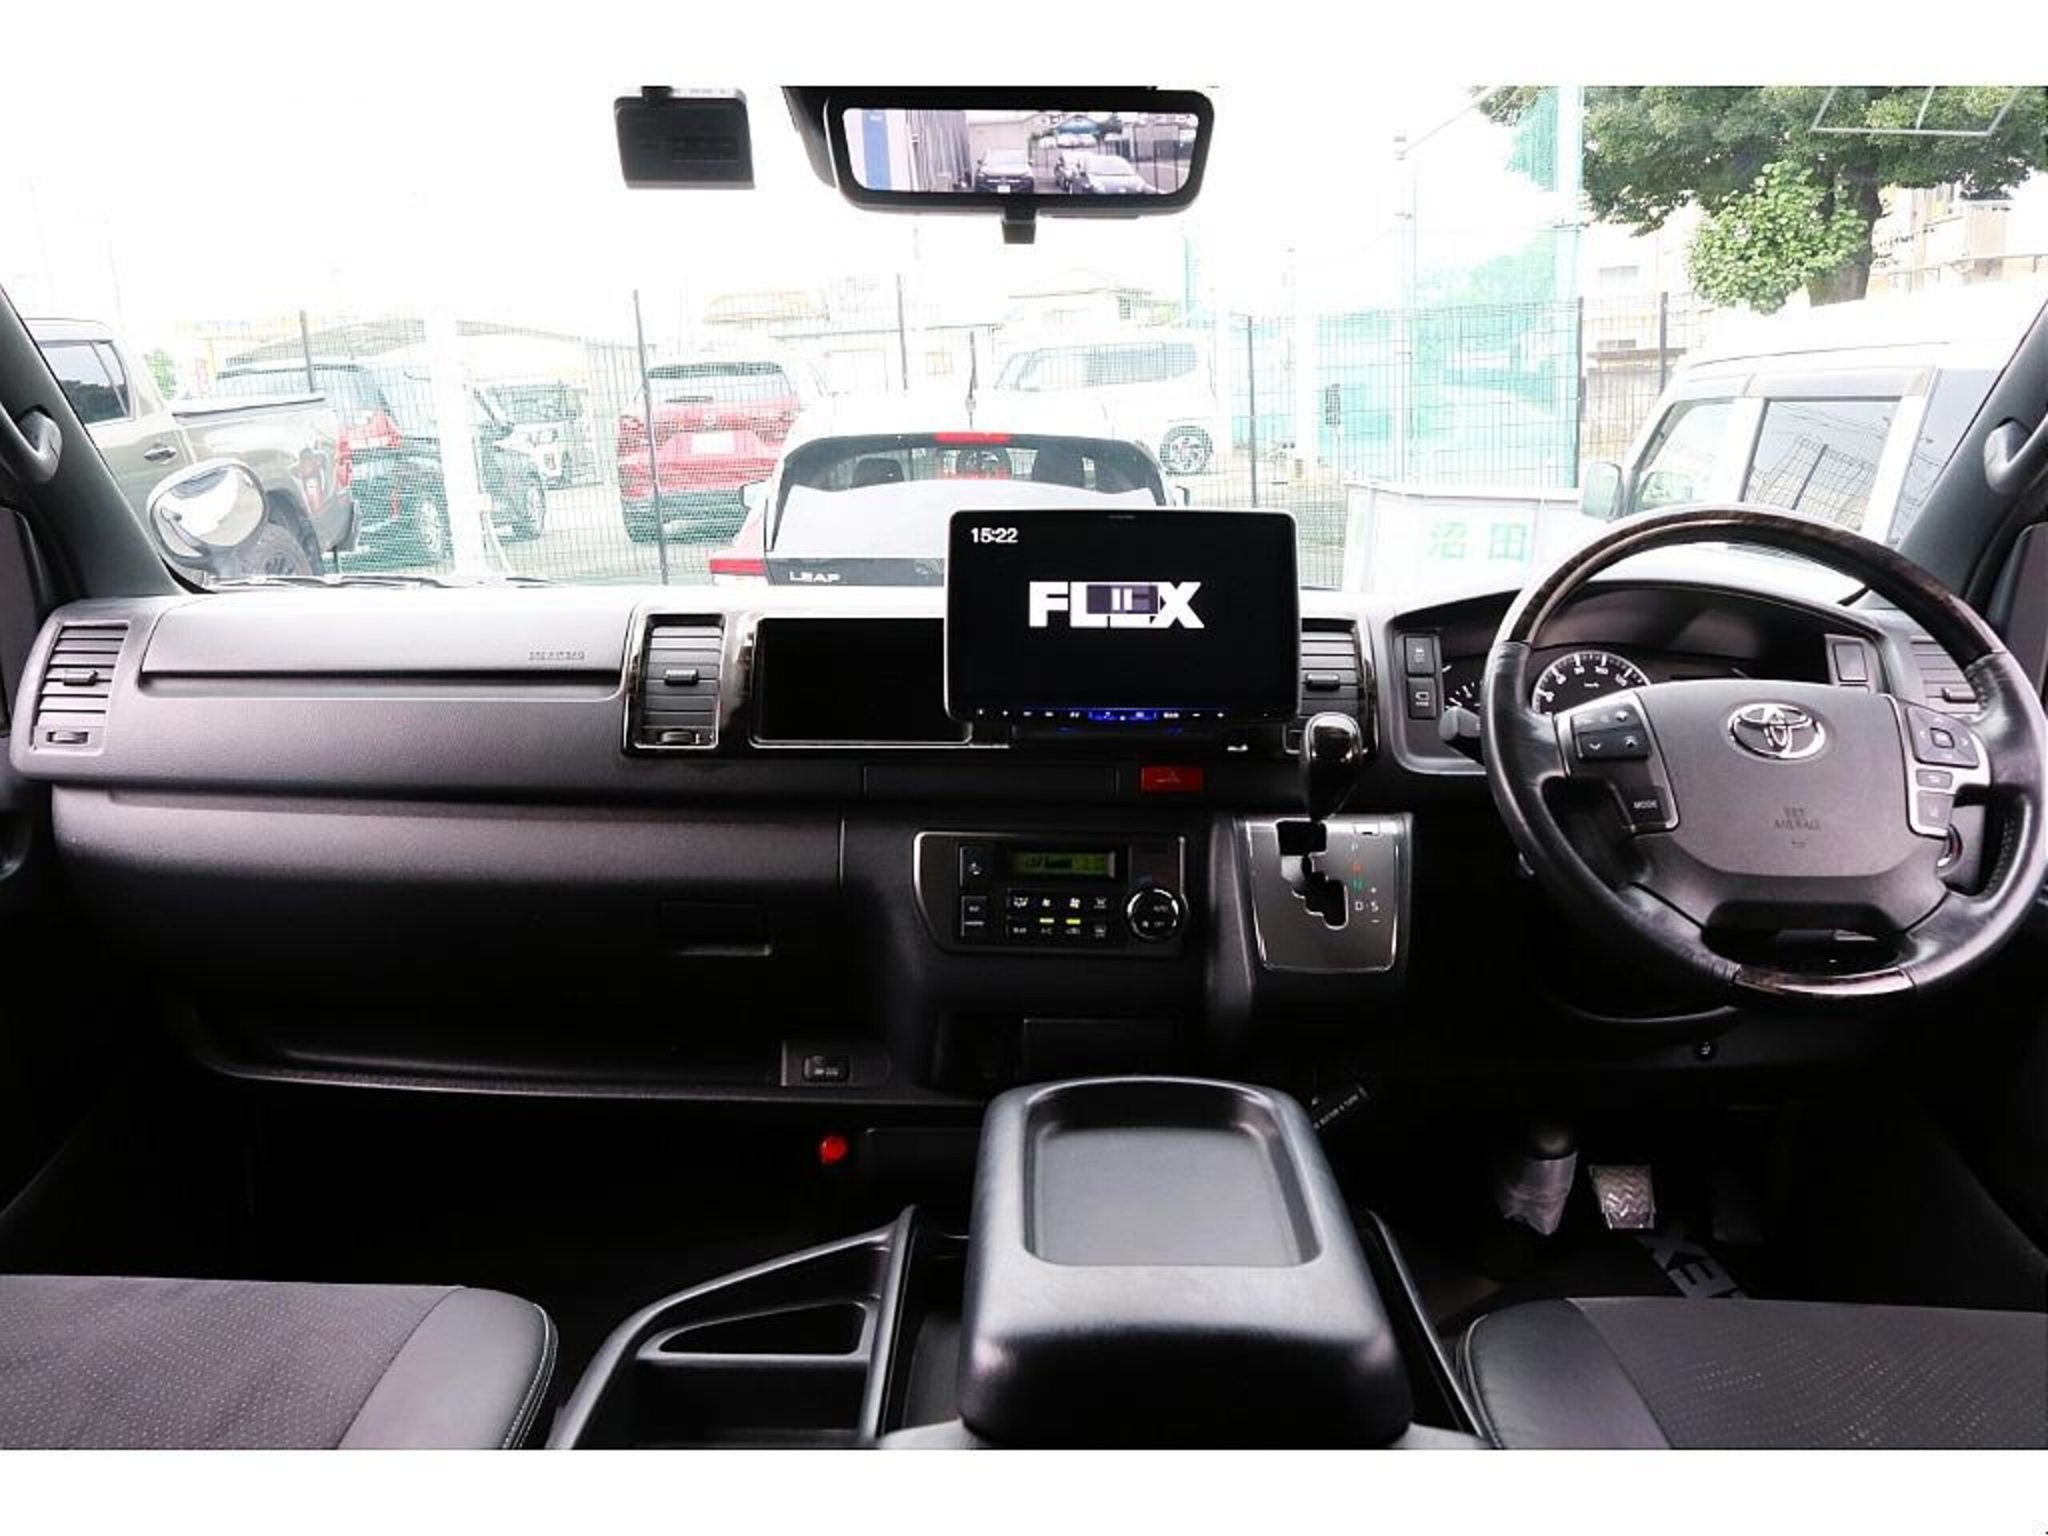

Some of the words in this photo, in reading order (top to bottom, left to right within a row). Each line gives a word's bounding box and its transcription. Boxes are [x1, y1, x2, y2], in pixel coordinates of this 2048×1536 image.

[970, 527, 1018, 543] 15:22
[1427, 521, 1528, 561] 沼田
[1355, 901, 1364, 911] D
